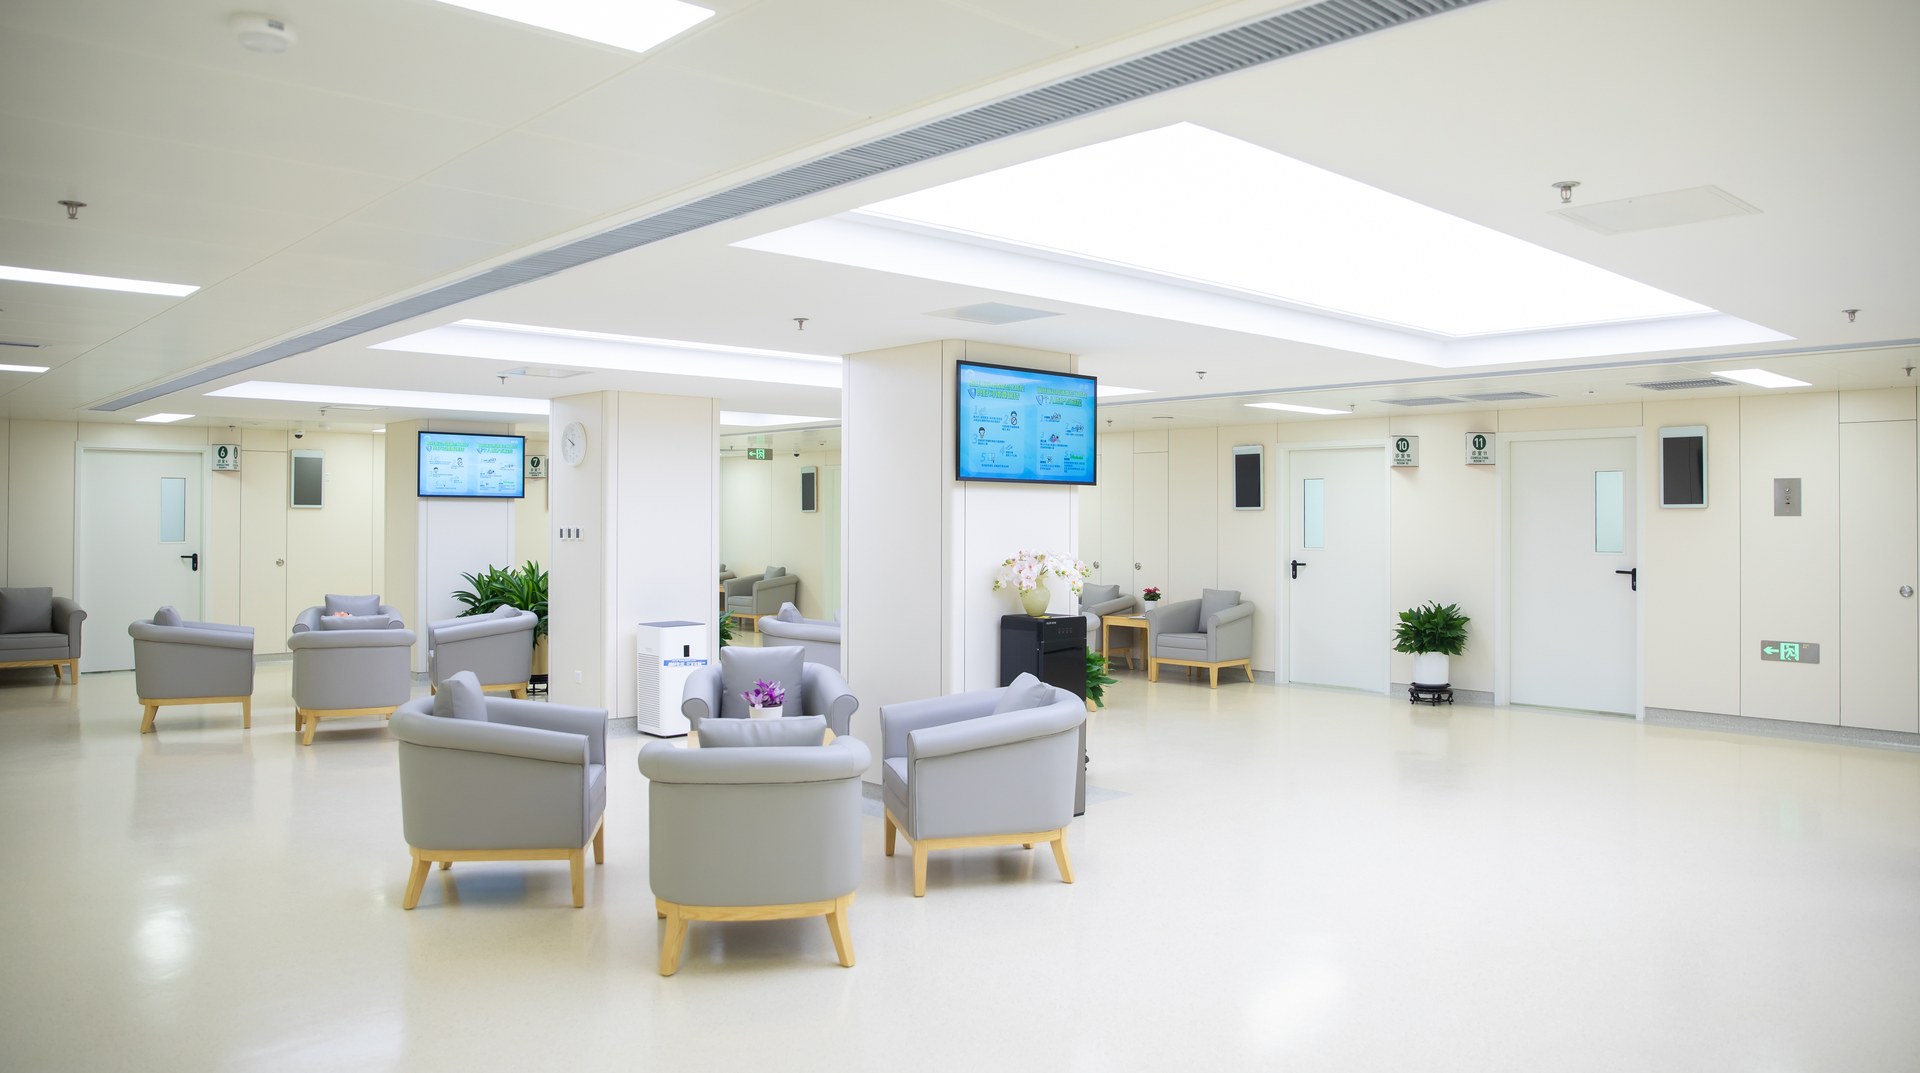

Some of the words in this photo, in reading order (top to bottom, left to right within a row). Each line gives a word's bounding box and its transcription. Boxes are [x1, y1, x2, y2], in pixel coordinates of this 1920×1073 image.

[1398, 440, 1407, 450] 10
[1474, 438, 1483, 447] 11
[220, 448, 225, 457] 6
[533, 458, 538, 467] 7
